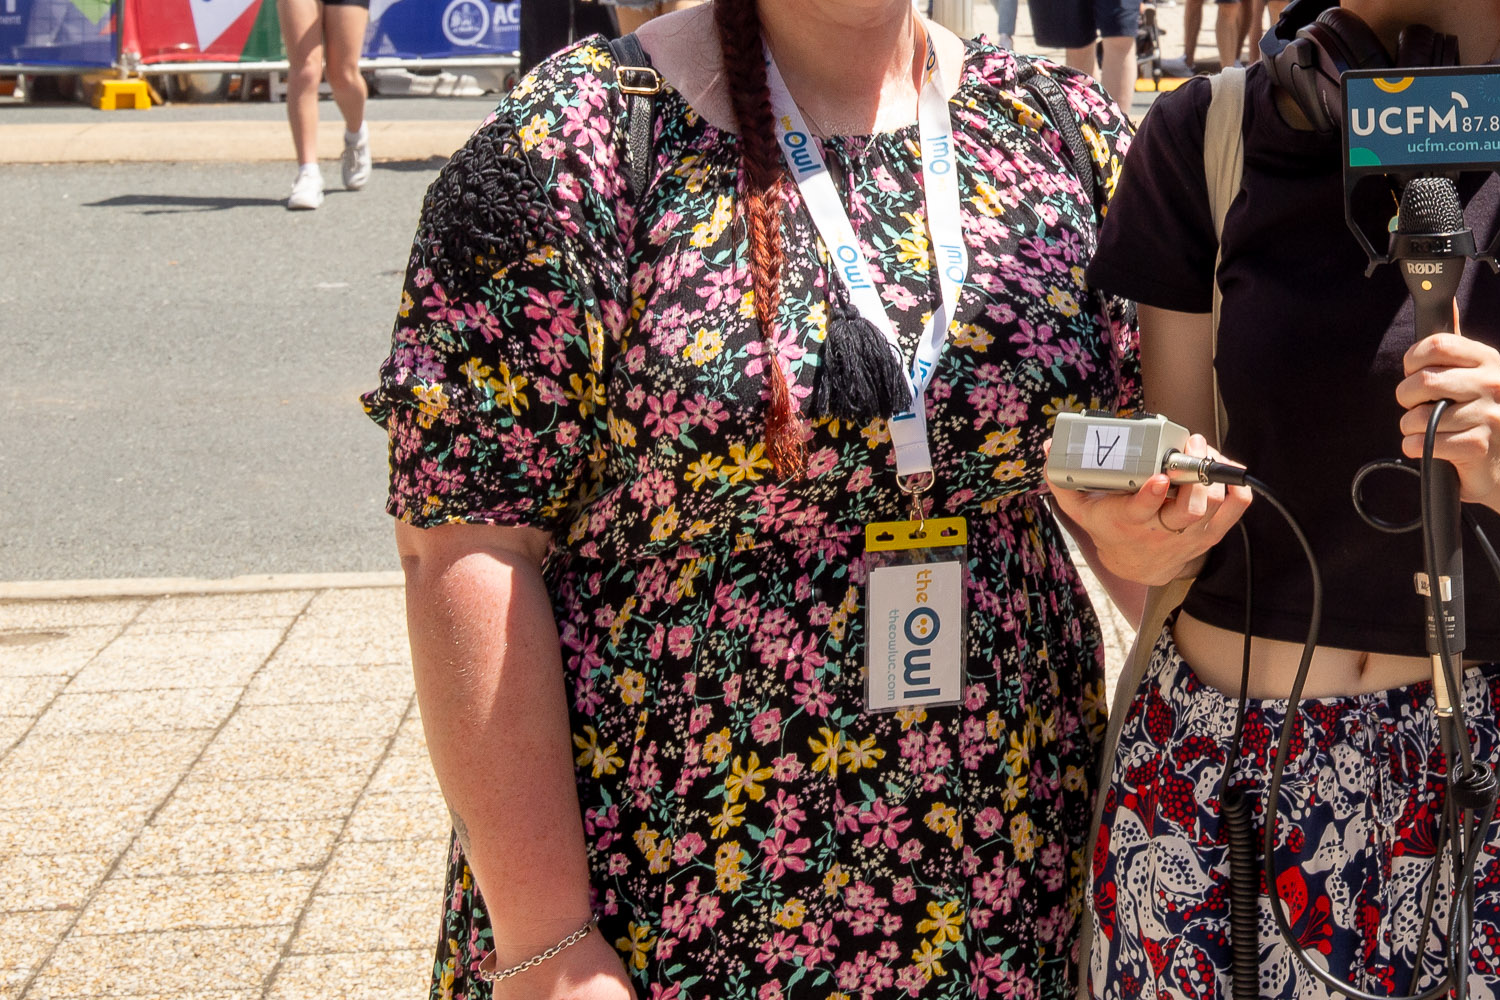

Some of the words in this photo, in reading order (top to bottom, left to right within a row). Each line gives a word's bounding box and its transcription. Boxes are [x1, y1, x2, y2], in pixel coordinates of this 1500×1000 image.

[493, 3, 521, 25] AC
[1351, 105, 1457, 136] UCFM
[1462, 115, 1500, 133] 87.8
[784, 131, 821, 173] Owl
[926, 135, 951, 175] Owl
[1407, 138, 1500, 153] ucfm.com.au
[836, 245, 871, 290] Owl
[939, 244, 965, 284] Owl
[1406, 262, 1443, 274] RØDE
[1096, 429, 1121, 467] A
[915, 568, 933, 604] the
[887, 608, 900, 701] theowluc.com
[903, 606, 941, 699] Owl
